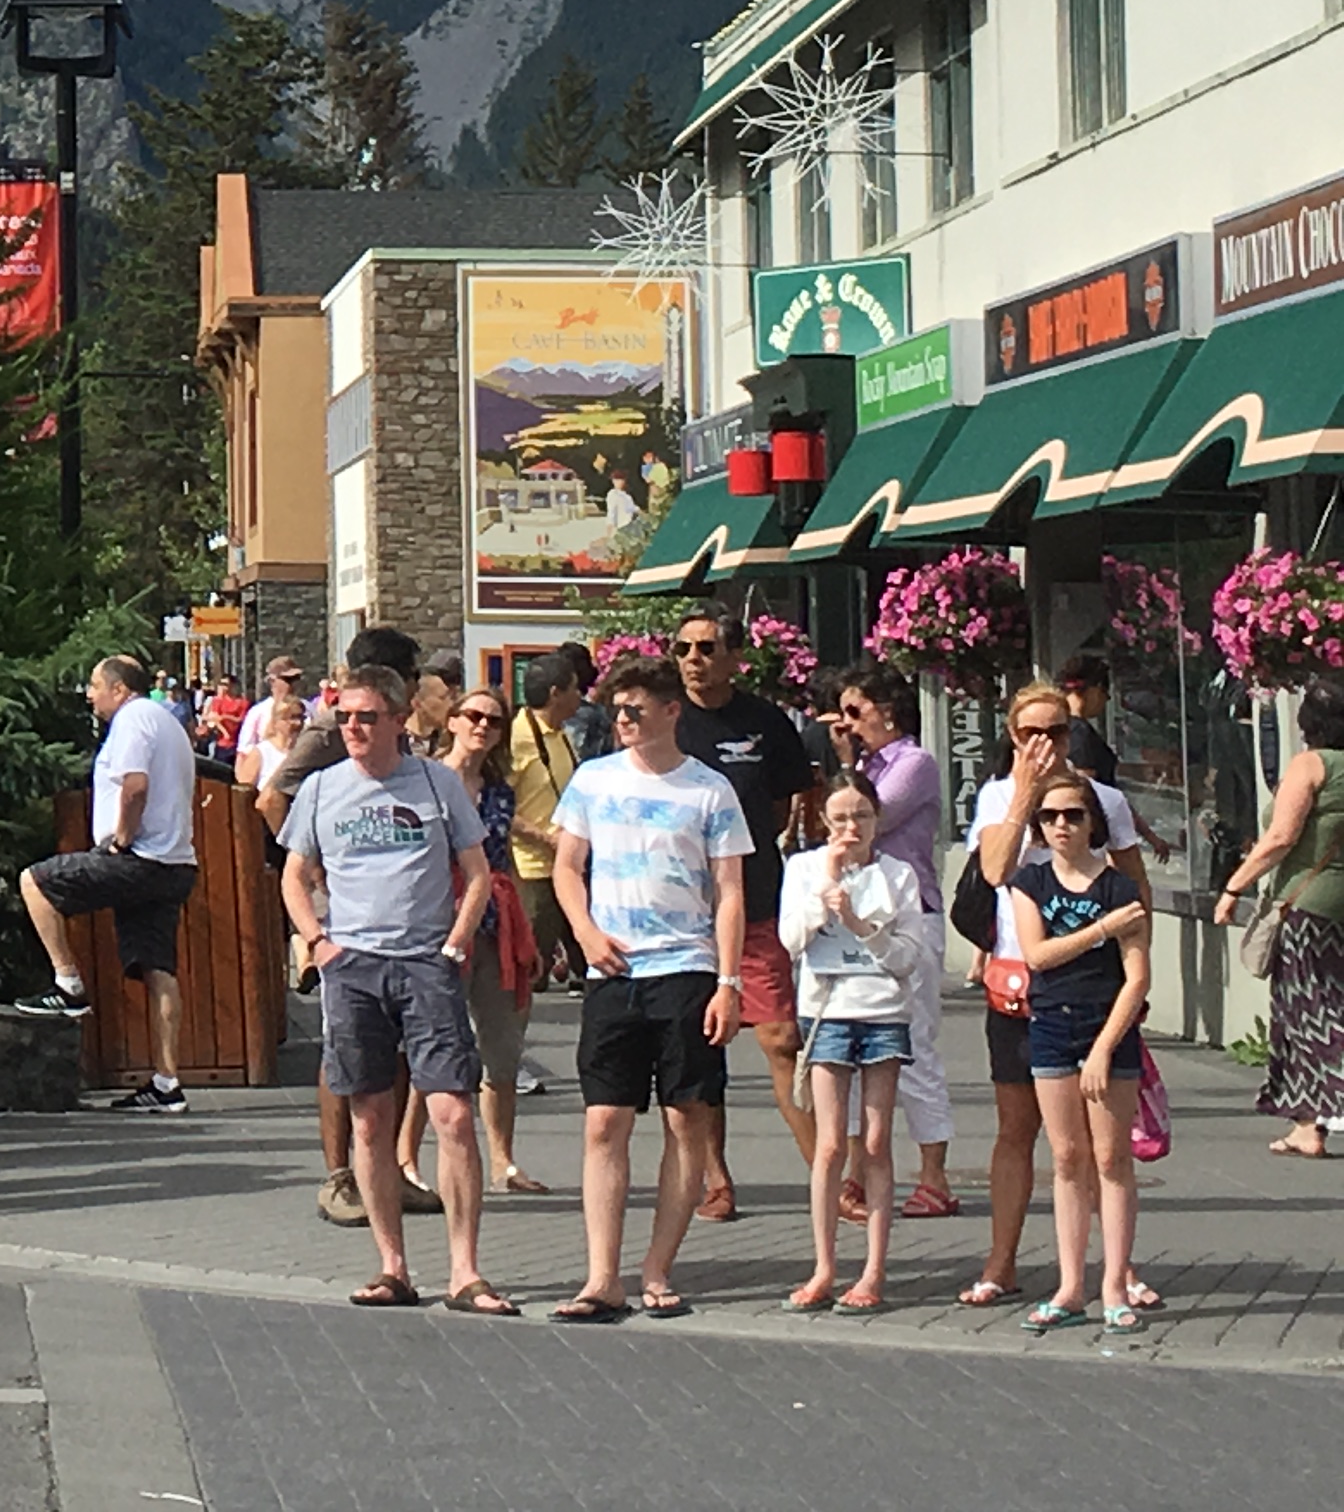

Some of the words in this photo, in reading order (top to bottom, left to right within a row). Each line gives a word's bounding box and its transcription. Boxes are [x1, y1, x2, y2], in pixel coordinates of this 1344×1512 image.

[1220, 218, 1294, 305] MOUNTAIN
[768, 289, 812, 353] Rose
[814, 273, 833, 304] &
[838, 272, 895, 345] Crown
[582, 331, 647, 351] BASIN
[359, 804, 392, 820] THE
[351, 832, 392, 847] FACE
